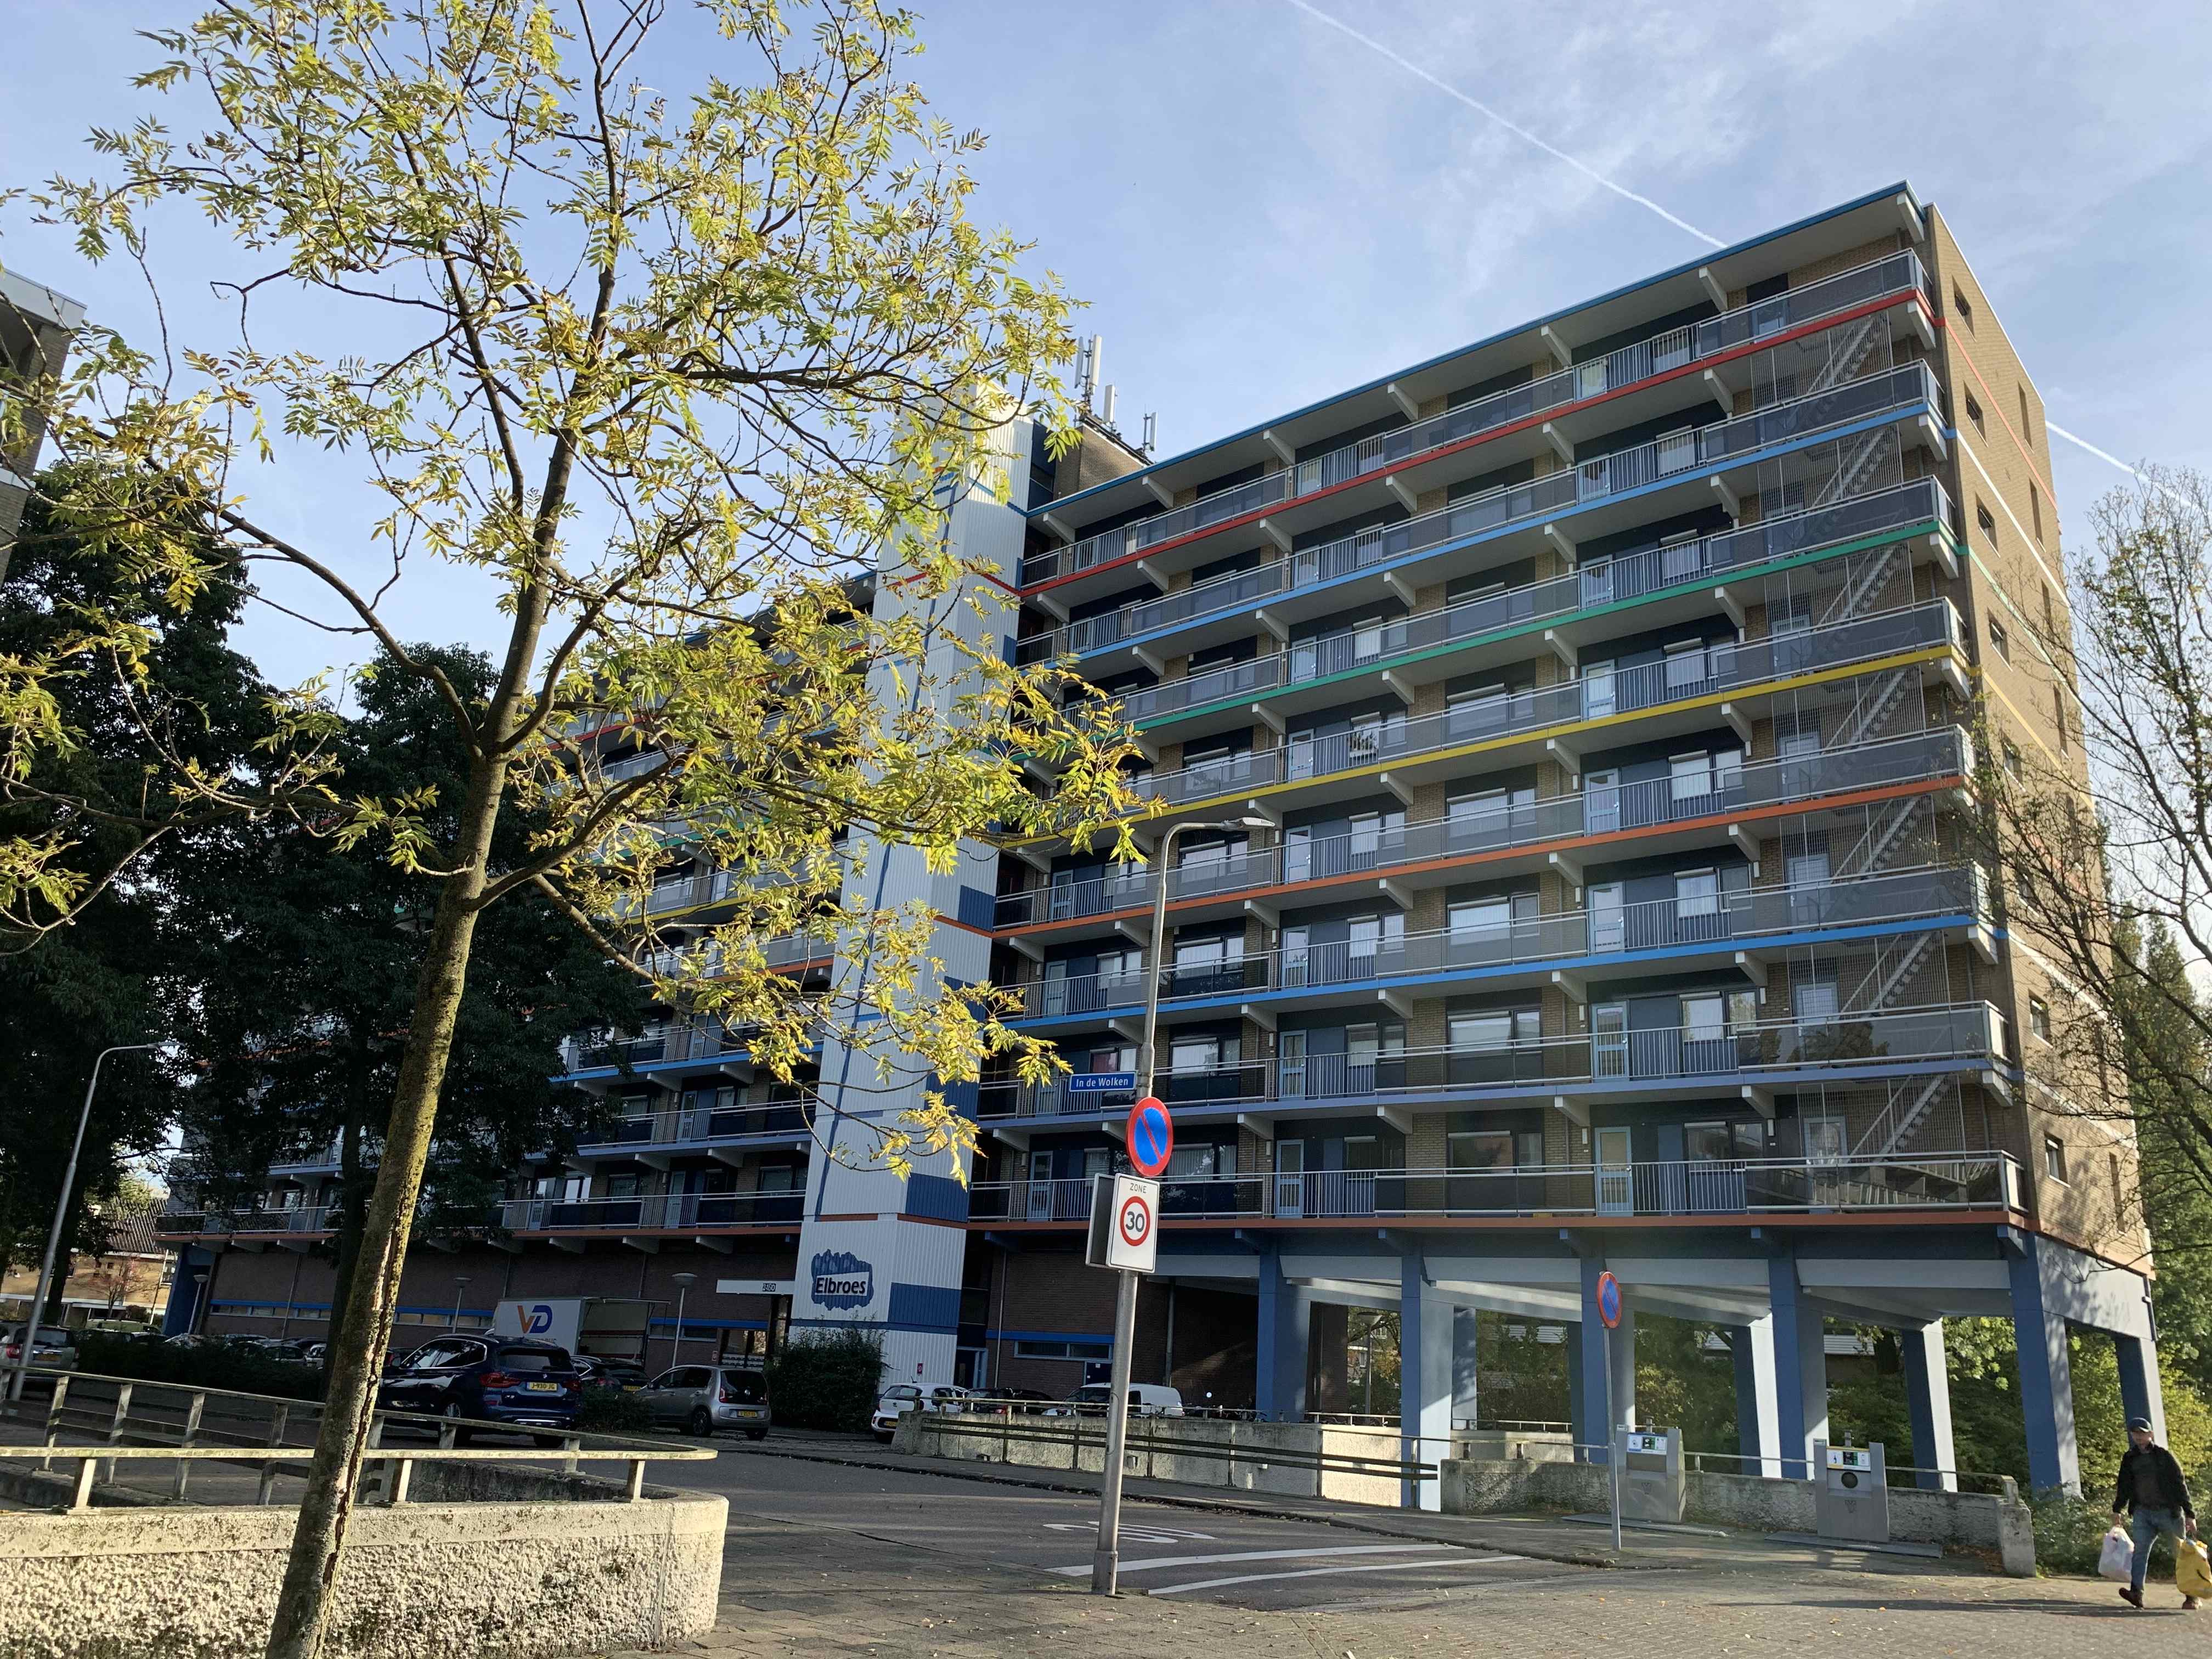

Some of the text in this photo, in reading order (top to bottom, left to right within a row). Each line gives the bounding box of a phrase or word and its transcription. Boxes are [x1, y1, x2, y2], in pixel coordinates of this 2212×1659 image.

[1076, 1077, 1128, 1087] In de Wolken
[1130, 1183, 1147, 1194] ZONE
[1125, 1211, 1145, 1233] 30
[815, 1277, 866, 1294] Elbroes
[517, 1305, 553, 1334] VD
